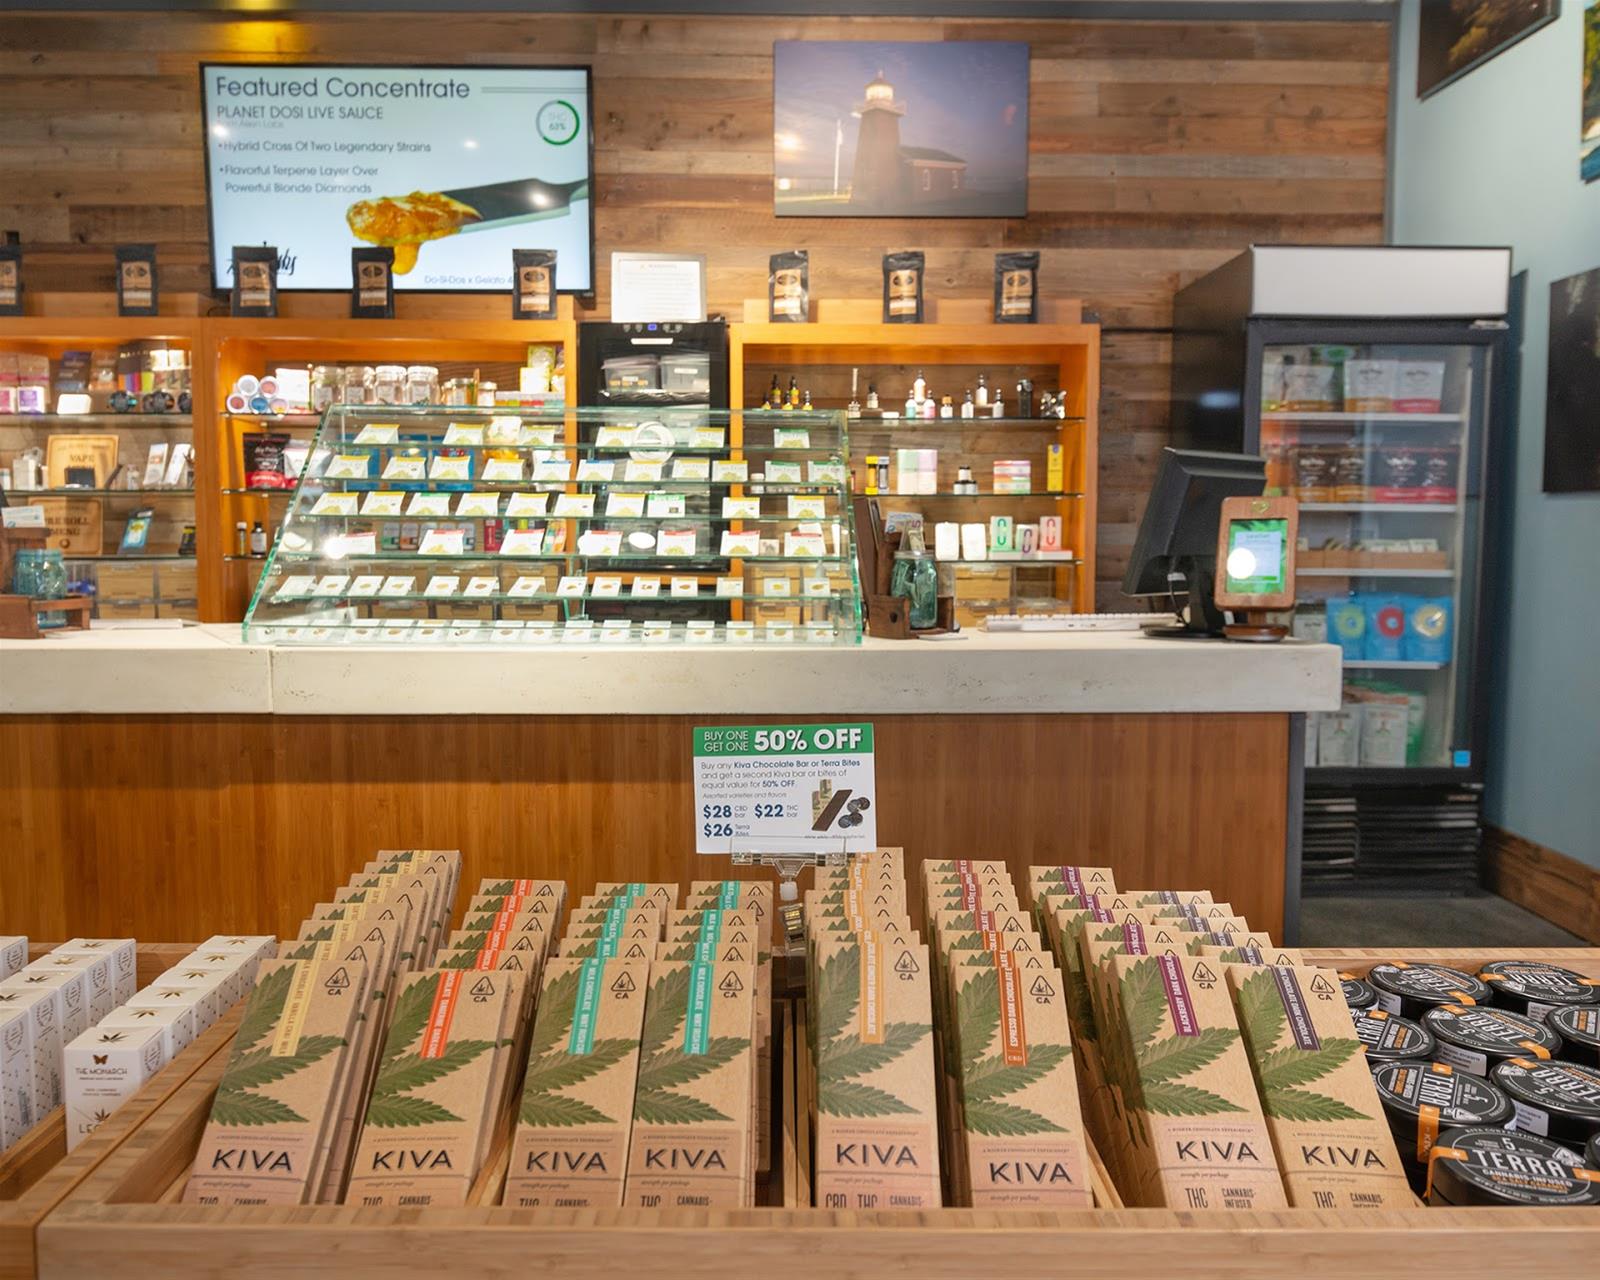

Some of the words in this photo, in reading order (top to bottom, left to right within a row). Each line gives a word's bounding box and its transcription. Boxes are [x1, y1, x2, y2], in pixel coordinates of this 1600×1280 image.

[216, 76, 318, 97] Featured
[326, 77, 470, 98] Concentrate
[217, 105, 266, 119] PLANET
[270, 105, 304, 119] DOSI
[308, 105, 335, 119] LIVE
[339, 105, 383, 119] SAUCE
[224, 140, 259, 152] Hybrid
[262, 141, 292, 151] Cross
[310, 141, 331, 151] Two
[334, 141, 392, 154] Legendary
[396, 141, 431, 152] Strains
[225, 164, 270, 175] Flavorful
[273, 165, 317, 178] Terpene
[320, 165, 349, 178] Layer
[352, 165, 378, 176] Over
[225, 182, 271, 193] Powerful
[274, 182, 312, 193] Blonde
[315, 182, 371, 194] Diamonds
[69, 454, 95, 462] VAPE
[704, 731, 724, 741] BUY
[726, 730, 749, 740] ONE
[754, 729, 808, 751] 50%
[813, 728, 861, 750] OFF
[704, 741, 724, 752] GET
[726, 741, 749, 751] ONE
[701, 761, 715, 770] Buy
[734, 761, 751, 769] Kiva
[752, 760, 794, 769] Chocolate
[796, 760, 809, 768] Bar
[821, 760, 841, 768] Terra
[842, 759, 861, 767] Bites
[702, 772, 718, 780] and
[719, 772, 733, 781] get
[742, 770, 771, 779] second
[773, 770, 790, 778] Kiva
[792, 769, 806, 778] bar
[818, 769, 837, 777] bites
[702, 780, 725, 790] equal
[726, 780, 748, 789] value
[762, 780, 779, 788] 50%
[780, 779, 795, 788] OFF
[703, 804, 732, 819] $28
[754, 803, 784, 819] $22
[703, 823, 733, 838] $26
[899, 973, 914, 981] CA
[327, 988, 342, 996] CA
[1004, 971, 1015, 1002] CHOCOLATE
[1170, 980, 1182, 997] DARK
[1199, 981, 1214, 990] CA
[1279, 974, 1297, 1003] CHOCOLATE
[473, 995, 488, 1003] CA
[615, 992, 629, 1000] CA
[723, 990, 738, 999] CA
[1035, 996, 1052, 1005] CA
[1318, 993, 1333, 1001] CA
[1007, 1002, 1016, 1018] DARK
[1174, 996, 1192, 1033] BLACKBERRY
[1289, 1001, 1302, 1015] DARK
[1008, 1017, 1018, 1047] ESPRESSO
[1294, 1015, 1312, 1045] CHOCOLATE
[75, 1067, 88, 1075] THE
[89, 1067, 128, 1075] MONARCH
[1418, 1072, 1455, 1107] TERRA
[1176, 1140, 1260, 1161] KIVA
[1501, 1136, 1516, 1151] 5
[212, 1149, 293, 1172] KIVA
[372, 1149, 453, 1170] KIVA
[526, 1151, 608, 1172] KIVA
[645, 1148, 727, 1169] KIVA
[836, 1143, 918, 1167] KIVA
[1301, 1145, 1387, 1169] KIVA
[1471, 1149, 1568, 1178] TERRA
[989, 1162, 1073, 1183] KIVA
[1185, 1187, 1208, 1208] THC
[1312, 1191, 1336, 1208] THC
